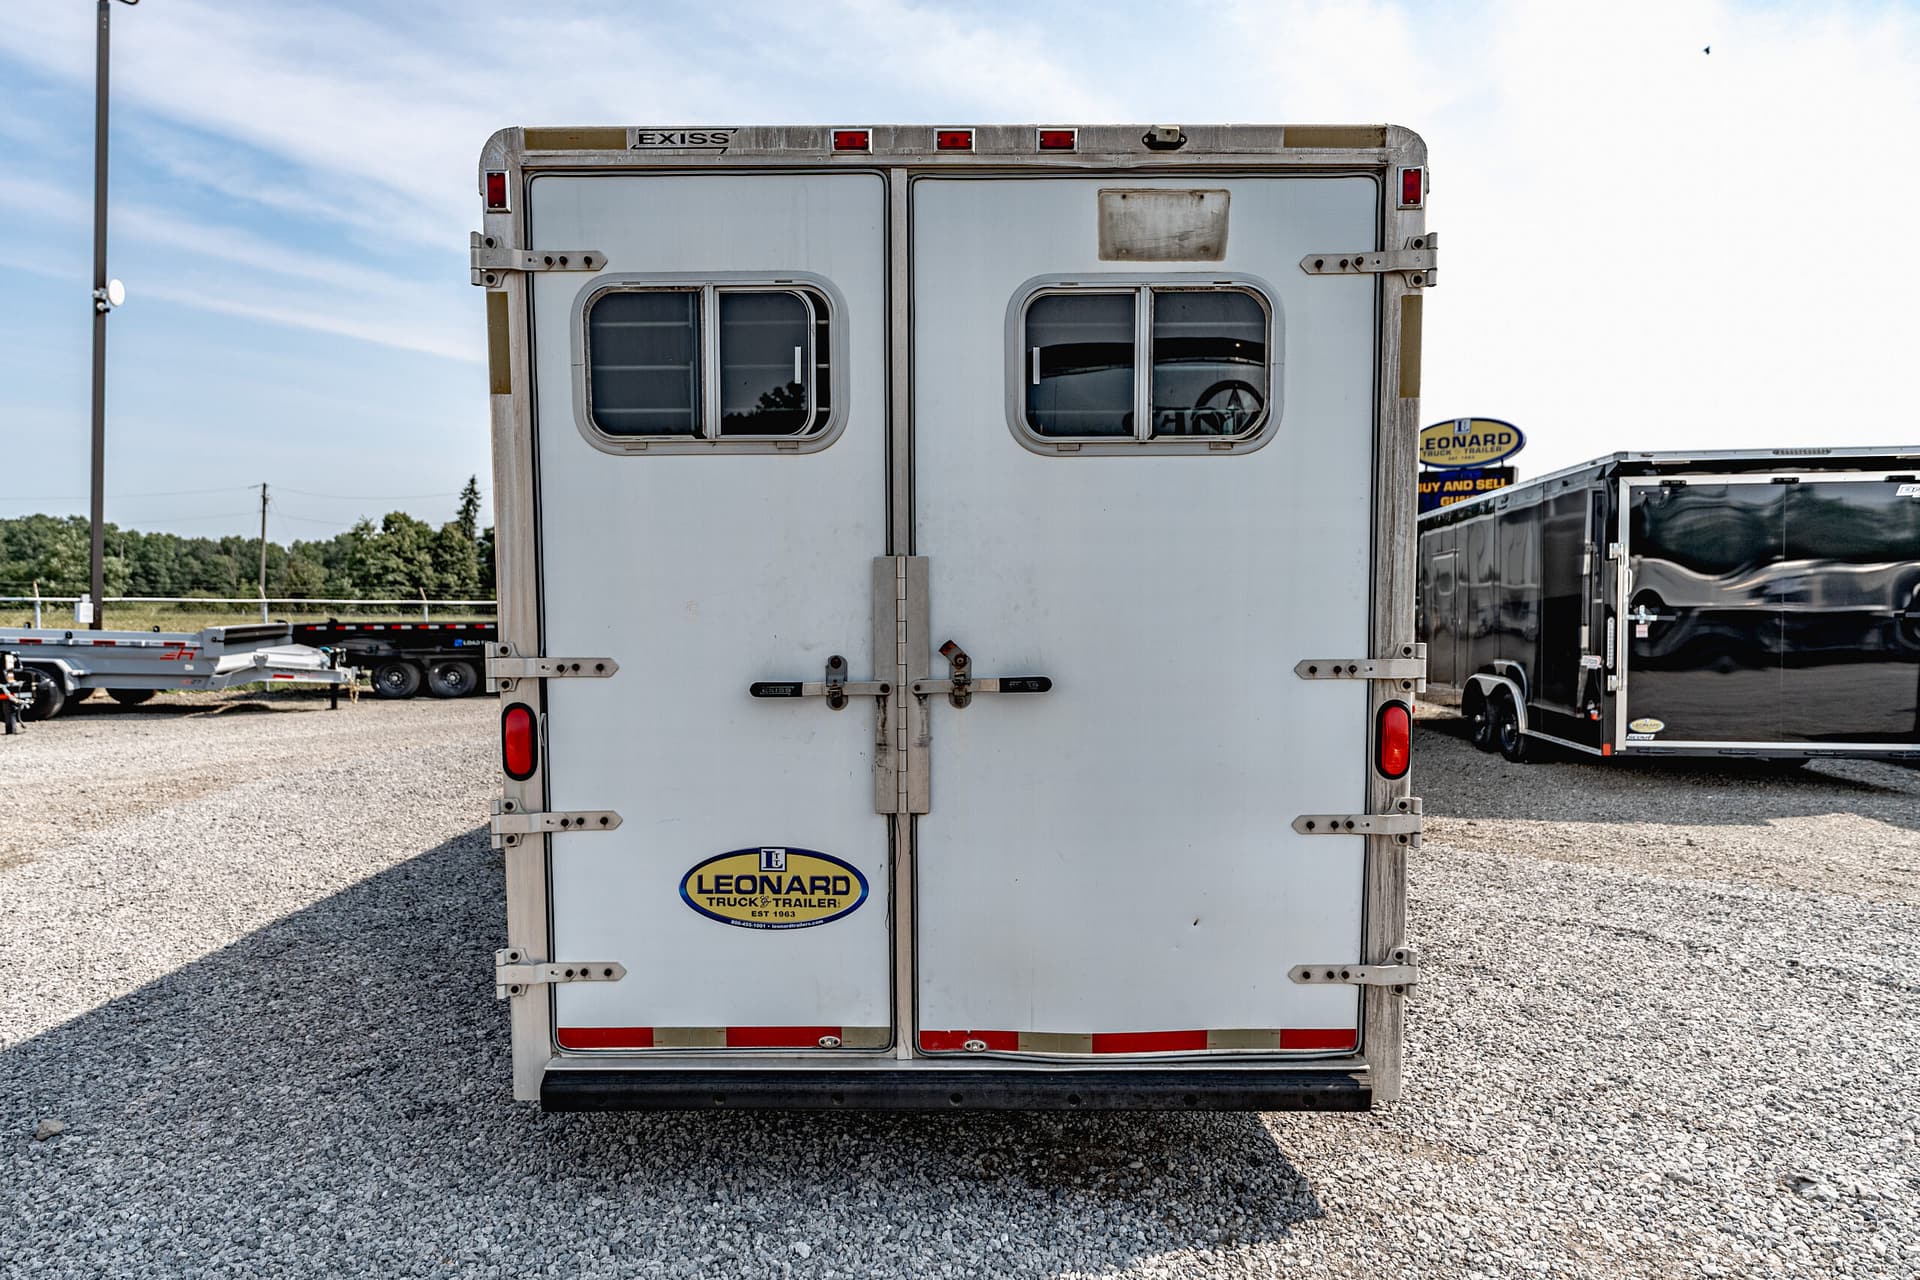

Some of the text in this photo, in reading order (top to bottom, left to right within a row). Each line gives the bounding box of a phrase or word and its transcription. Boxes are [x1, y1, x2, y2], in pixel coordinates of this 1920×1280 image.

[638, 132, 730, 145] EXISS
[1420, 432, 1512, 450] EONARD
[1423, 446, 1502, 457] TRUCK TRAILER
[1443, 480, 1474, 492] AND
[1476, 478, 1507, 490] SELL
[697, 875, 851, 895] LEONARD
[706, 897, 759, 907] TRUCK
[773, 897, 837, 908] TRAILER
[773, 910, 796, 918] 1963
